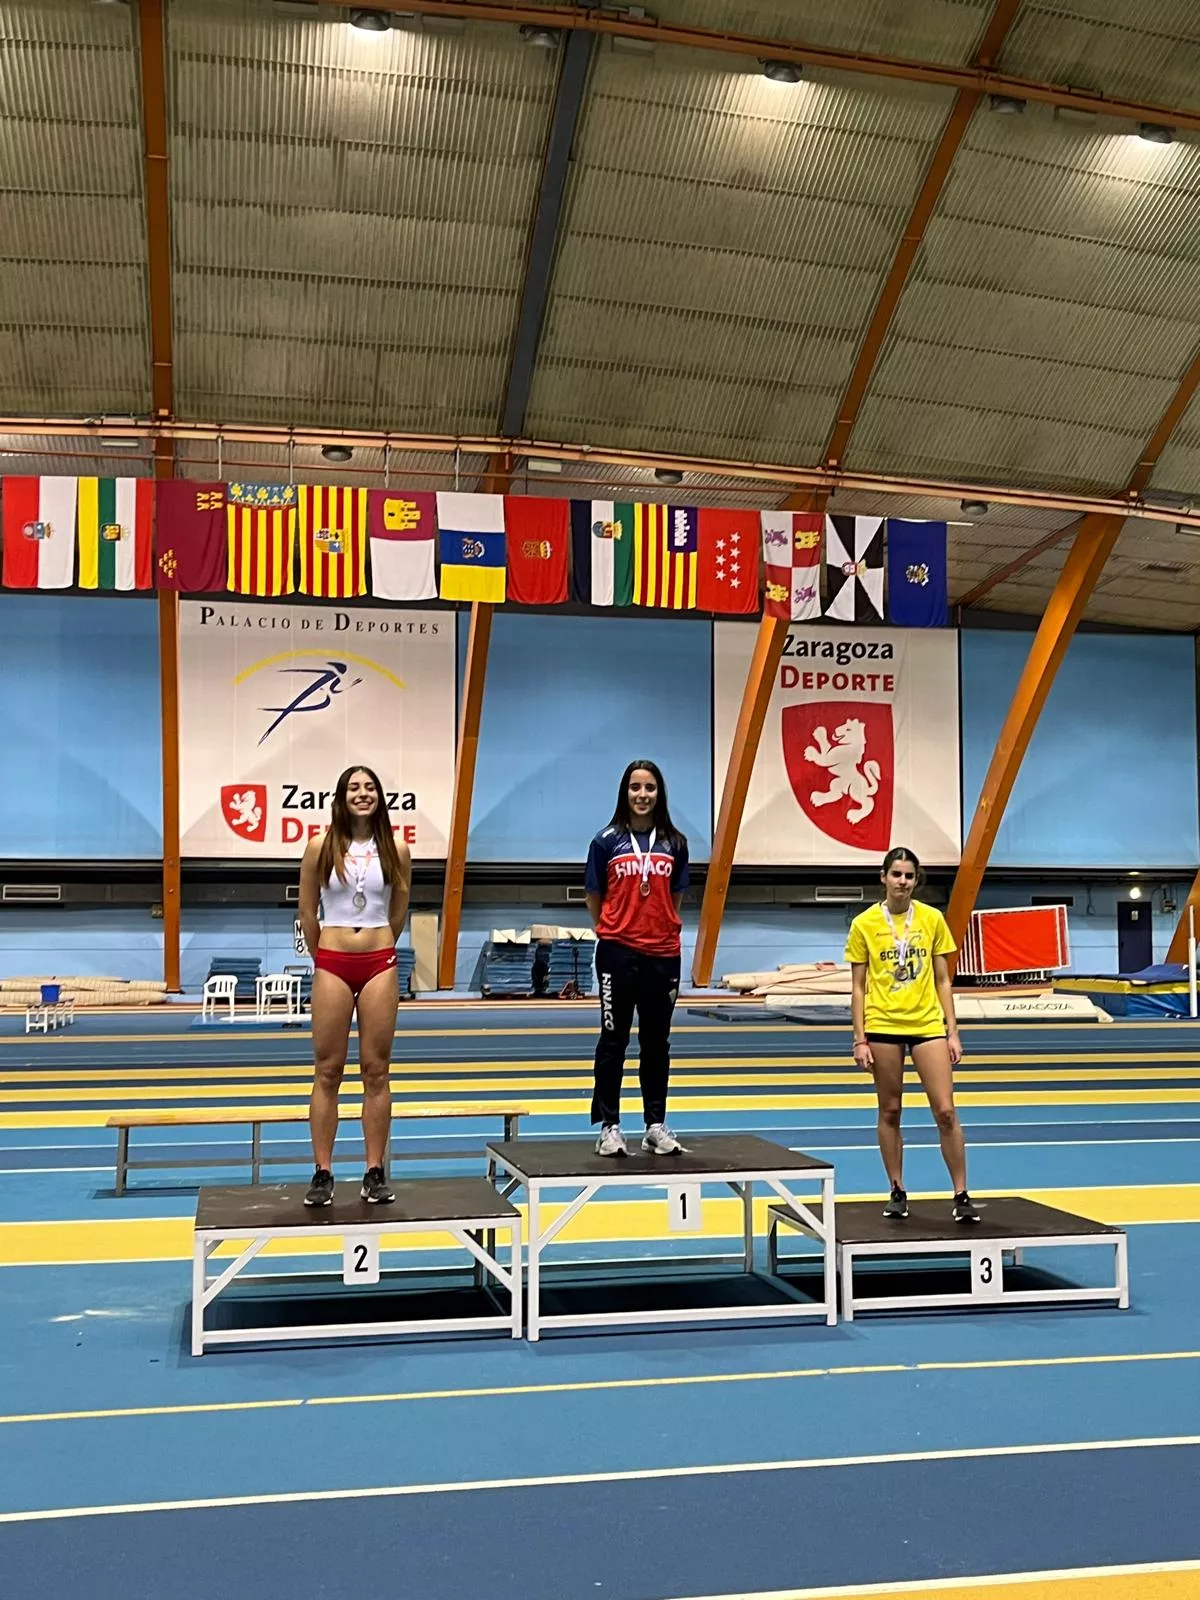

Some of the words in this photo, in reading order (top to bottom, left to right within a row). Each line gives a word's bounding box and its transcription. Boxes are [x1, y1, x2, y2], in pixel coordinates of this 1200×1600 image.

[301, 619, 324, 631] DE
[781, 634, 894, 666] Zaragoza
[780, 664, 895, 693] DEPORTE
[281, 784, 417, 811] Zarza
[880, 948, 927, 961] SCOPIO
[679, 1192, 687, 1220] 1
[353, 1244, 369, 1273] 2
[980, 1257, 993, 1284] 3
